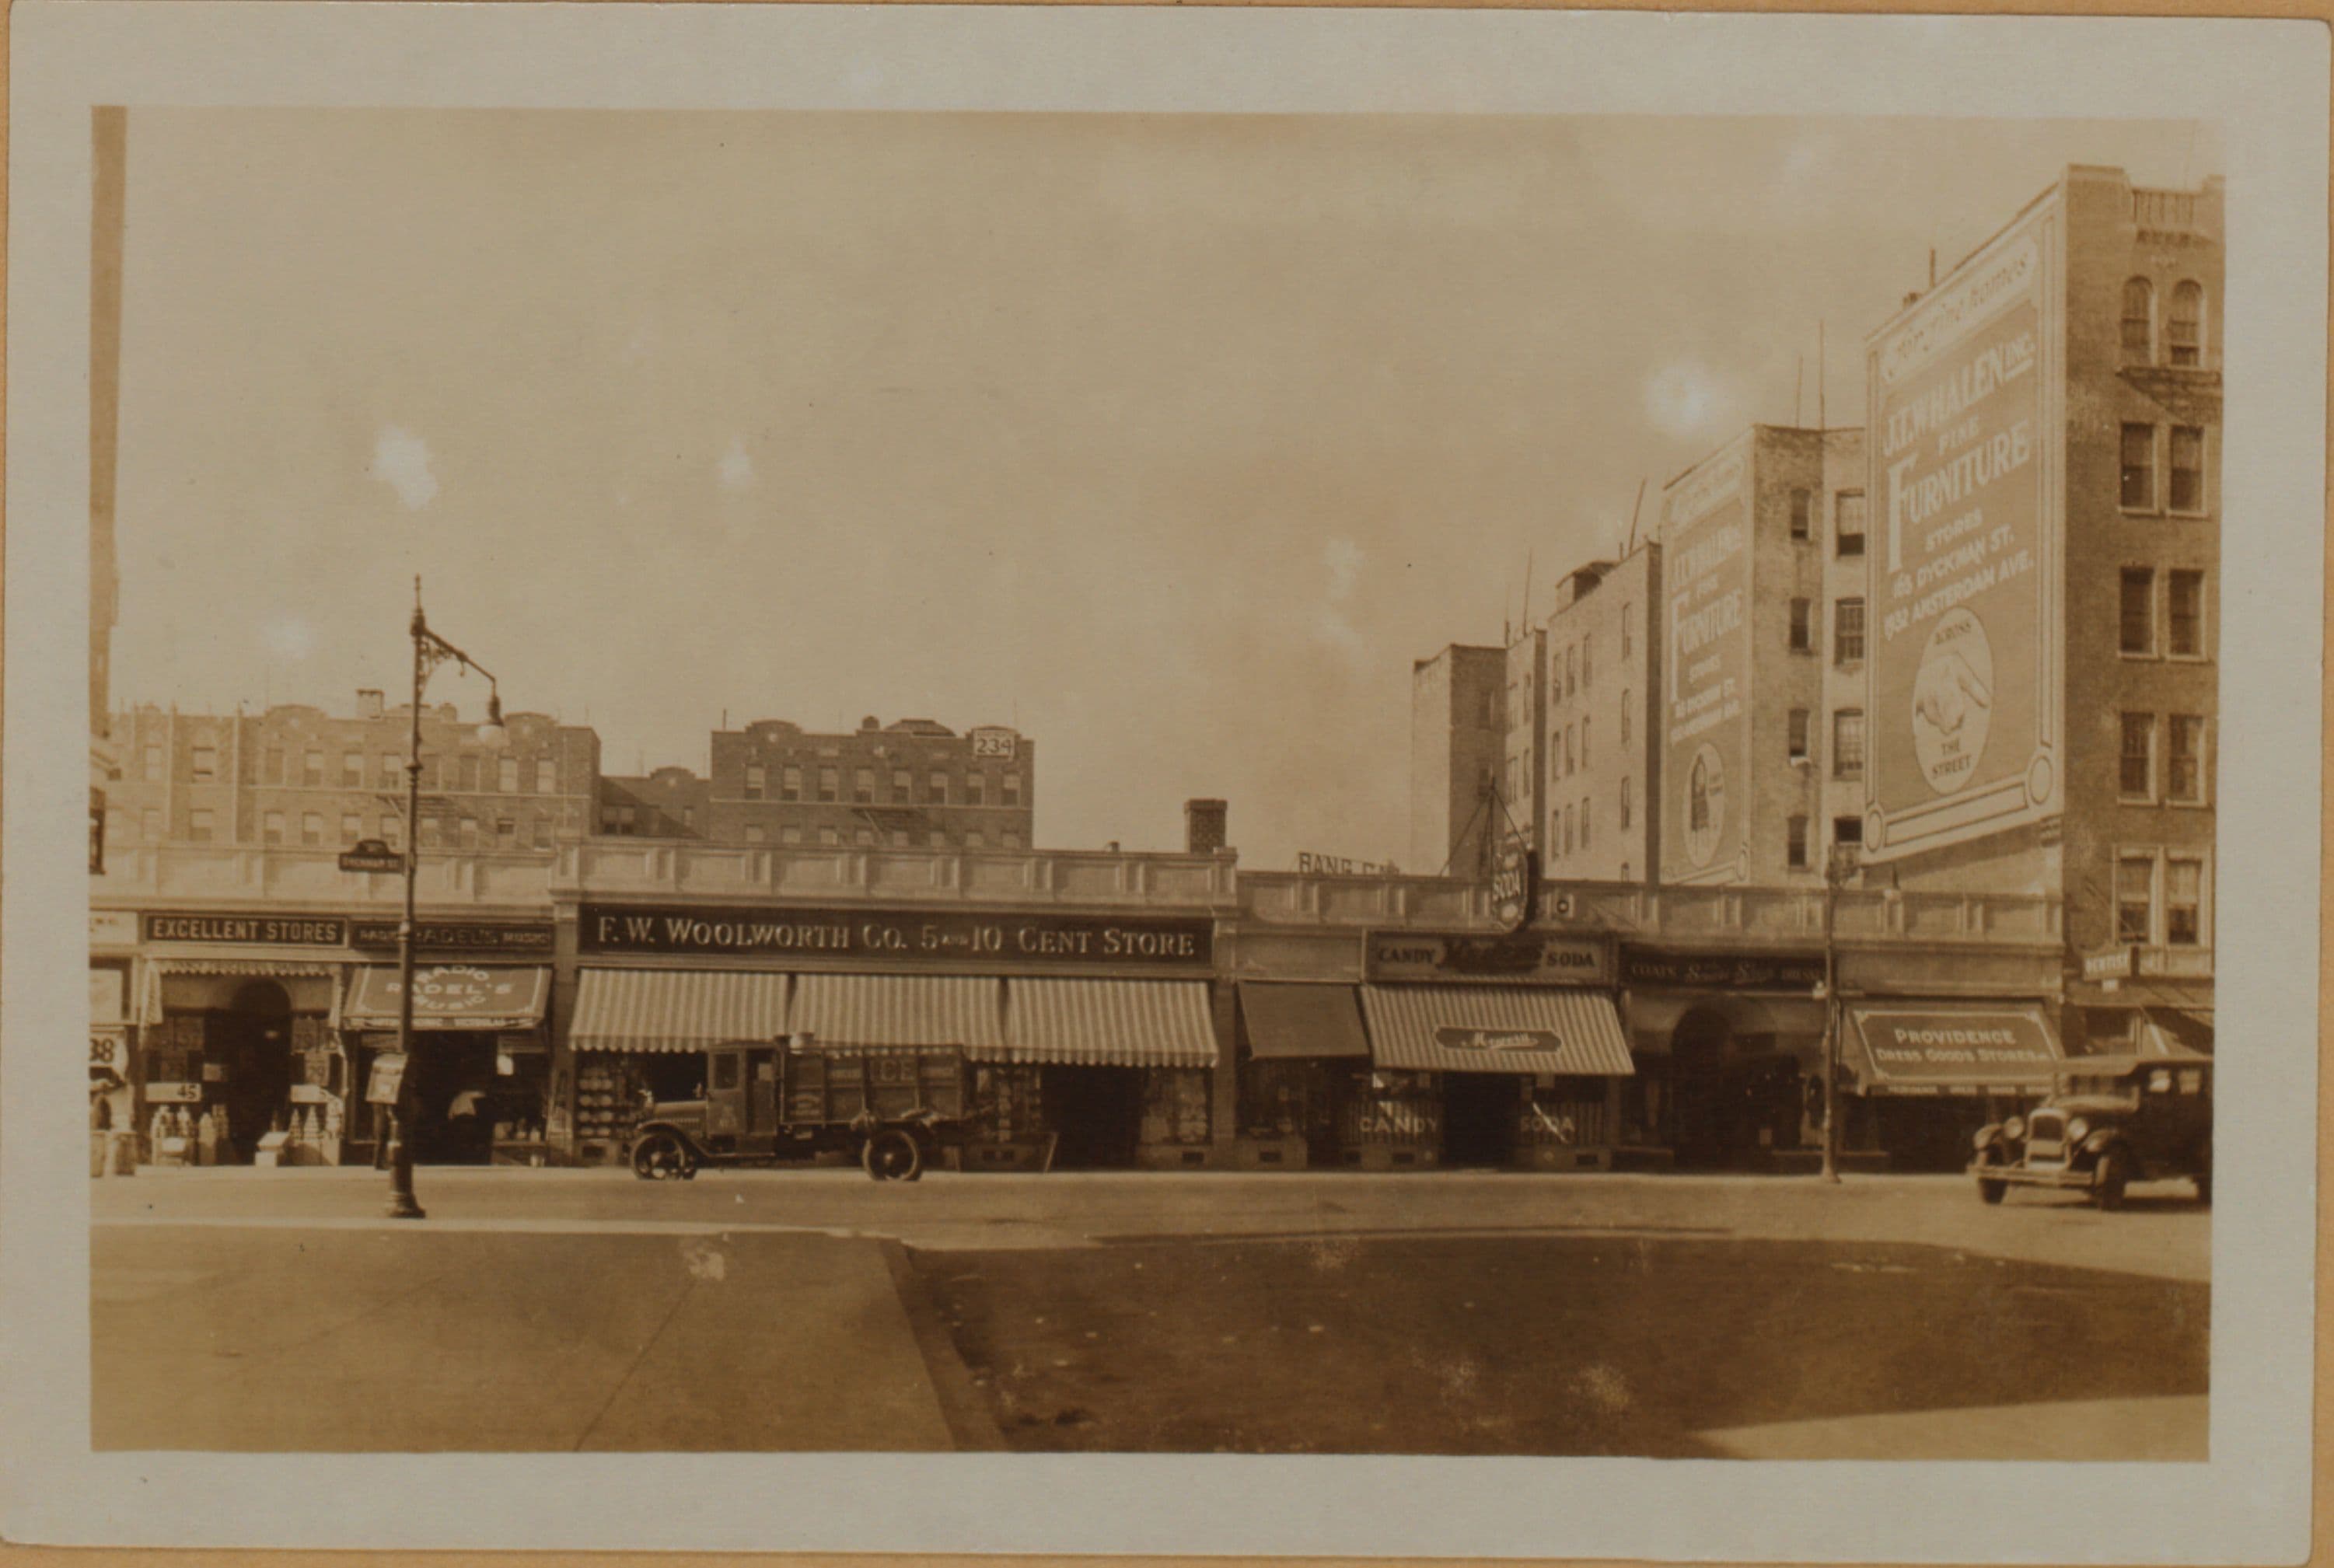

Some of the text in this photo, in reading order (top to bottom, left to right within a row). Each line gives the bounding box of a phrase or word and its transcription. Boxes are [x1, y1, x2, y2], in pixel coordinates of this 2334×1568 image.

[1887, 420, 2031, 575] FURNITURE
[1925, 507, 1983, 553] STORES
[1912, 564, 1996, 622] AMSTERDAM
[977, 738, 1012, 754] 234
[1931, 755, 1972, 781] STREET
[154, 919, 337, 941] EXCELLENT STORES
[598, 917, 620, 942] F.
[626, 917, 655, 943] W.
[666, 918, 850, 948] WOOLWORTH
[920, 924, 938, 949] 5
[972, 926, 1001, 952] 10
[1378, 948, 1436, 965] CANDY
[1547, 952, 1595, 968] SODA
[414, 966, 490, 984] RADIO
[1894, 1028, 2017, 1045] PROVIDENCE
[870, 1059, 916, 1082] ICE
[1360, 1116, 1438, 1133] CANDY
